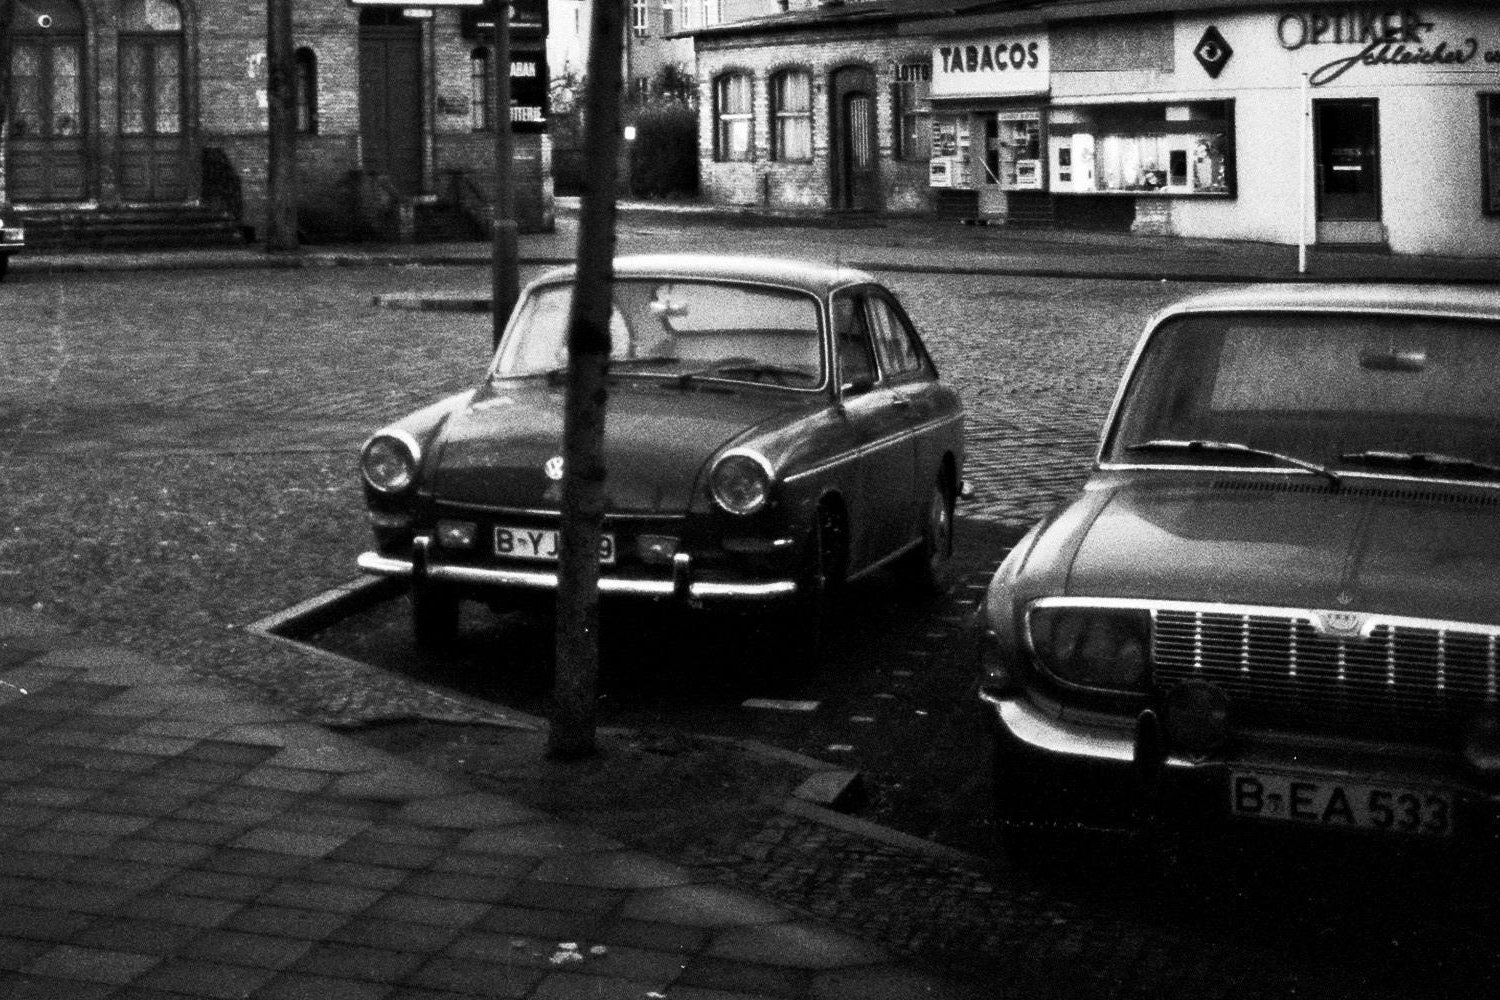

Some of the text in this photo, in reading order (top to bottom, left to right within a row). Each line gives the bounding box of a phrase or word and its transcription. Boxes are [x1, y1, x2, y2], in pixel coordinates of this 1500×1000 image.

[510, 62, 536, 77] ABAK
[940, 42, 1039, 73] TABACOS
[895, 64, 930, 81] LOTTO
[1368, 790, 1450, 833] 533
